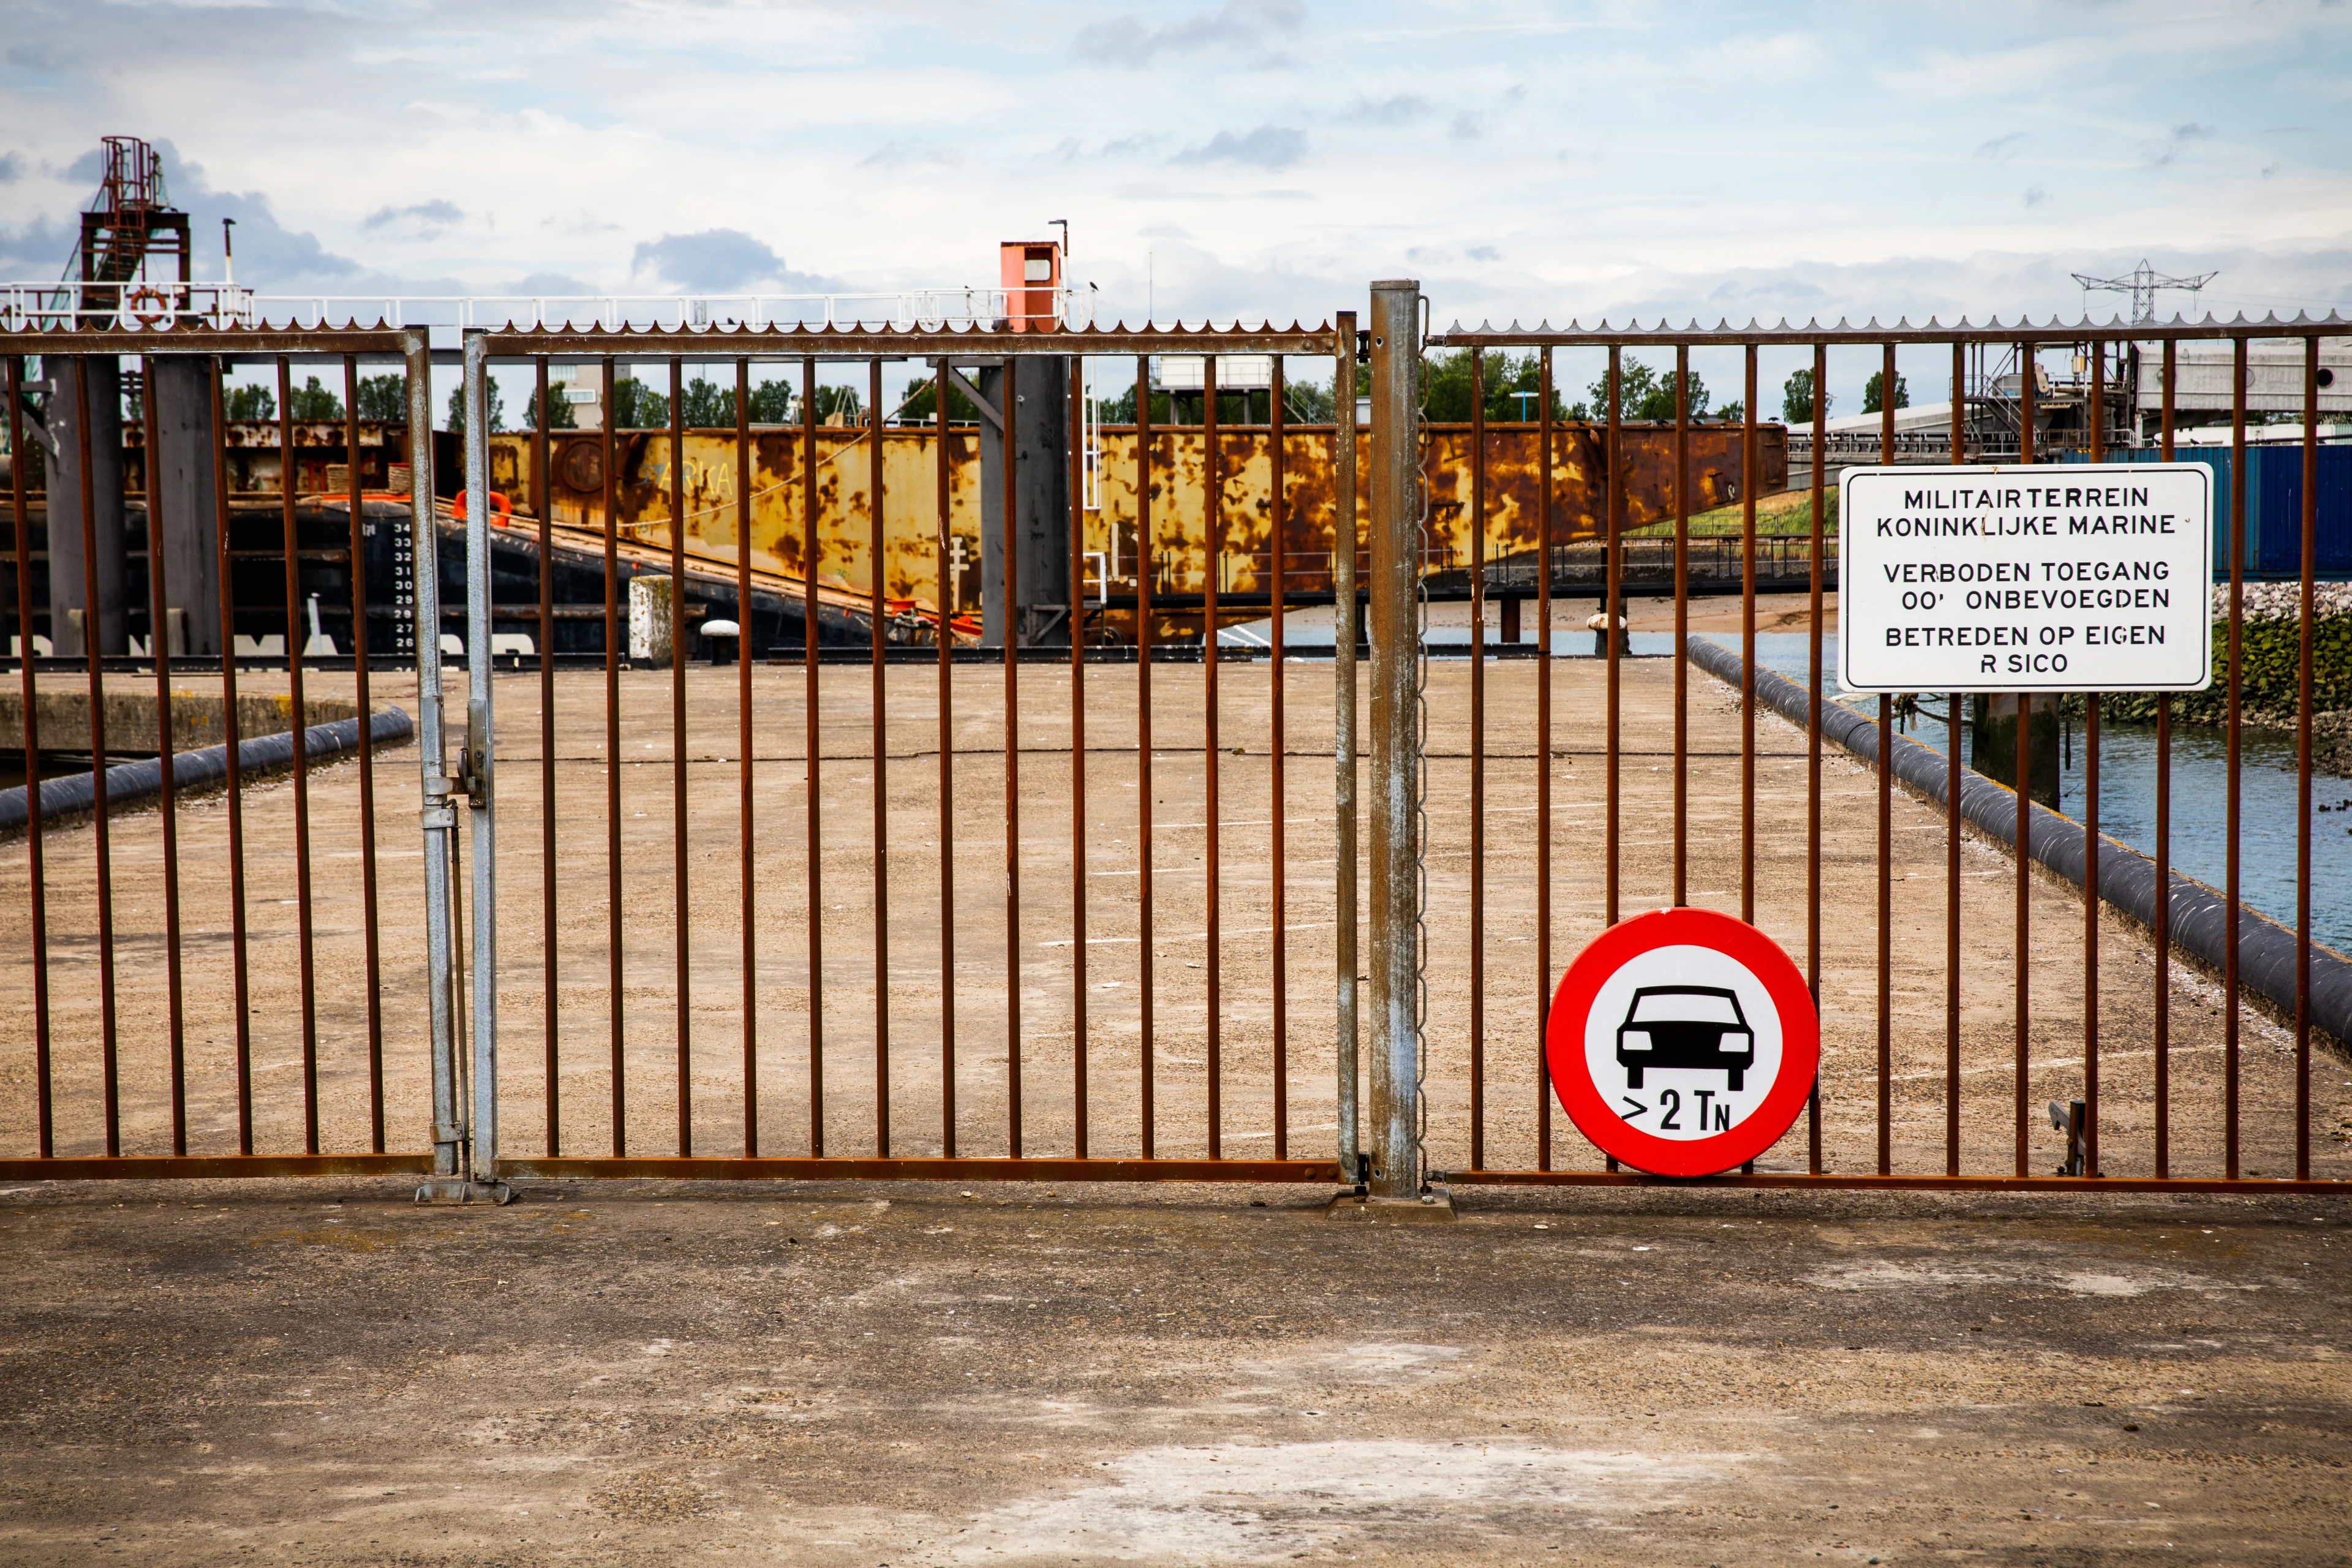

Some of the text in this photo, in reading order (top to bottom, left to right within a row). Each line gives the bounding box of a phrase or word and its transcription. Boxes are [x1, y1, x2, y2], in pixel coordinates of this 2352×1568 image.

[394, 524, 410, 533] 34
[1877, 514, 2175, 537] KONINKLIJKE MARINE
[394, 538, 412, 547] 33
[394, 552, 412, 562] 32
[395, 567, 410, 576] 31
[1883, 561, 2169, 583] VERBODEN TOEGANG
[395, 581, 413, 590] 30
[396, 595, 413, 605] 29
[1966, 589, 2169, 609] ONBEVOEGDEN
[396, 624, 413, 633] 27
[1886, 625, 2165, 647] BETREDEN OP EIGEN
[396, 638, 413, 647] 26
[1660, 1089, 1681, 1131] 2
